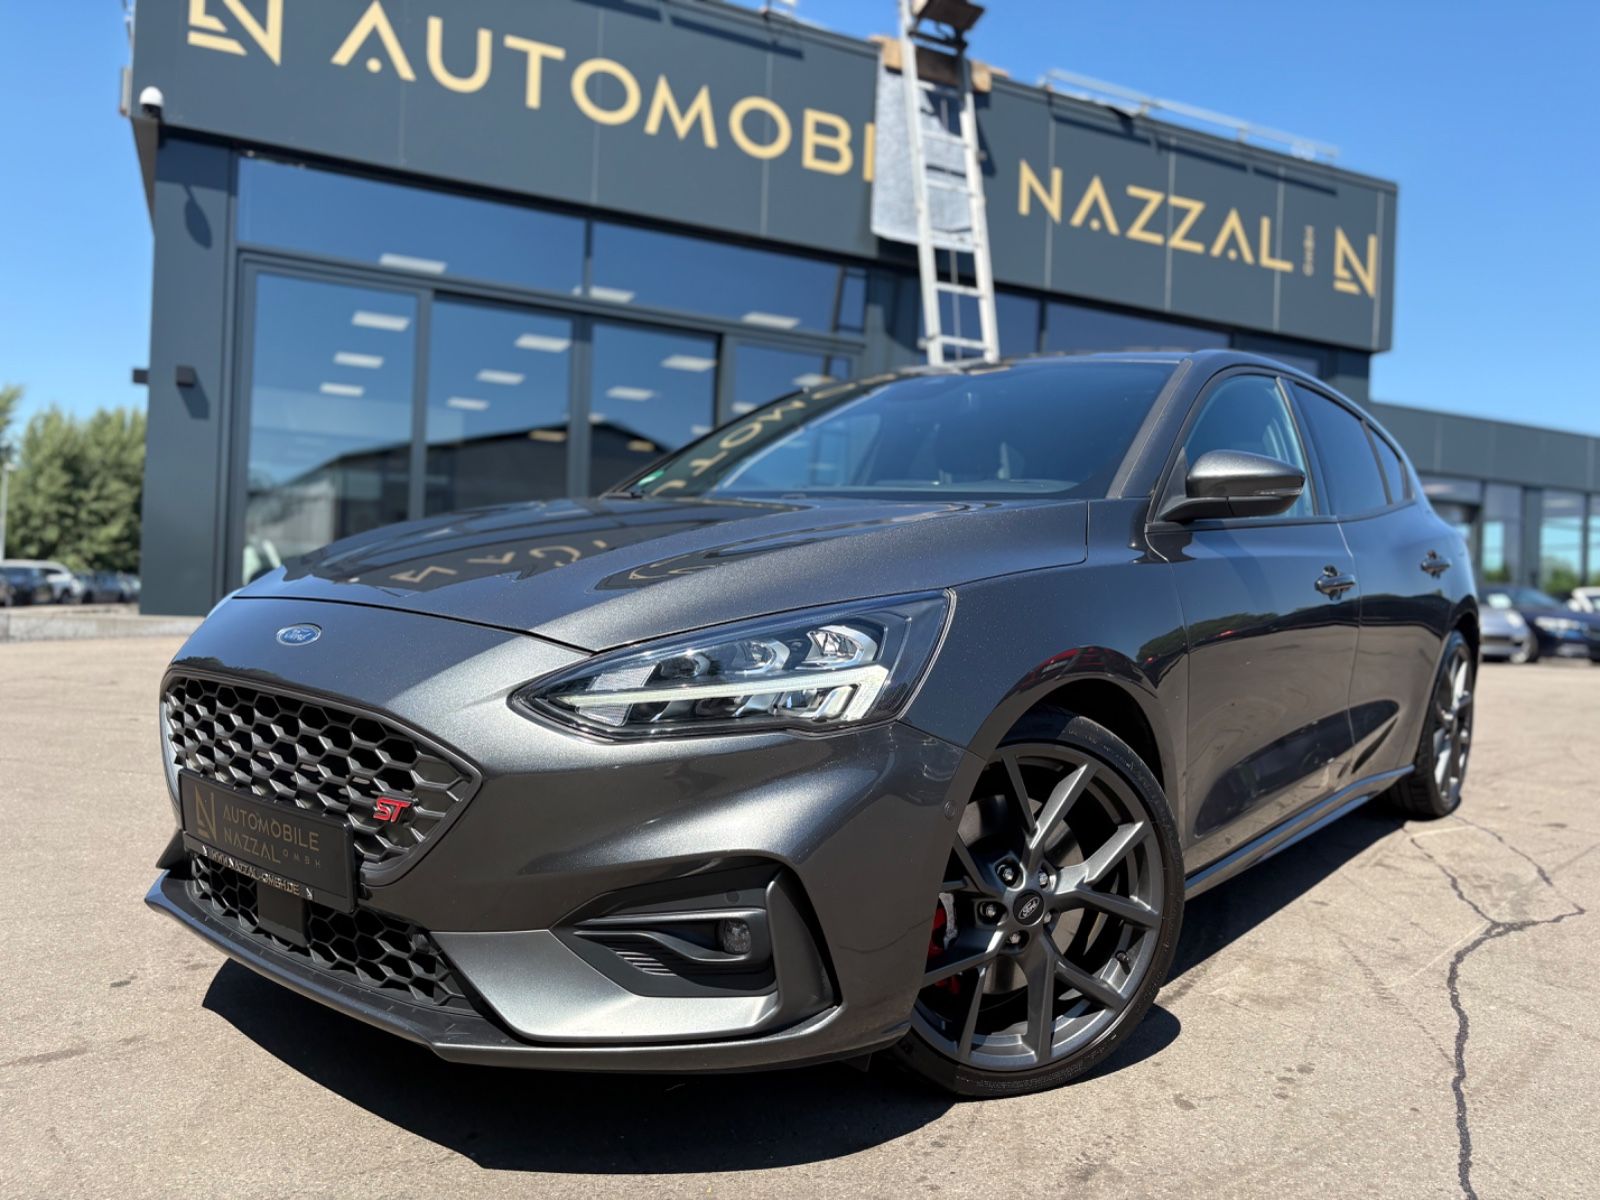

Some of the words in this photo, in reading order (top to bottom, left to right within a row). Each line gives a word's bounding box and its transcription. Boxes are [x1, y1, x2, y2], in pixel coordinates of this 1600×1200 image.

[1018, 159, 1294, 273] NAZZAL
[222, 804, 320, 852] AUTOMOBILE
[372, 796, 411, 822] ST
[223, 827, 281, 864] NAZZAL
